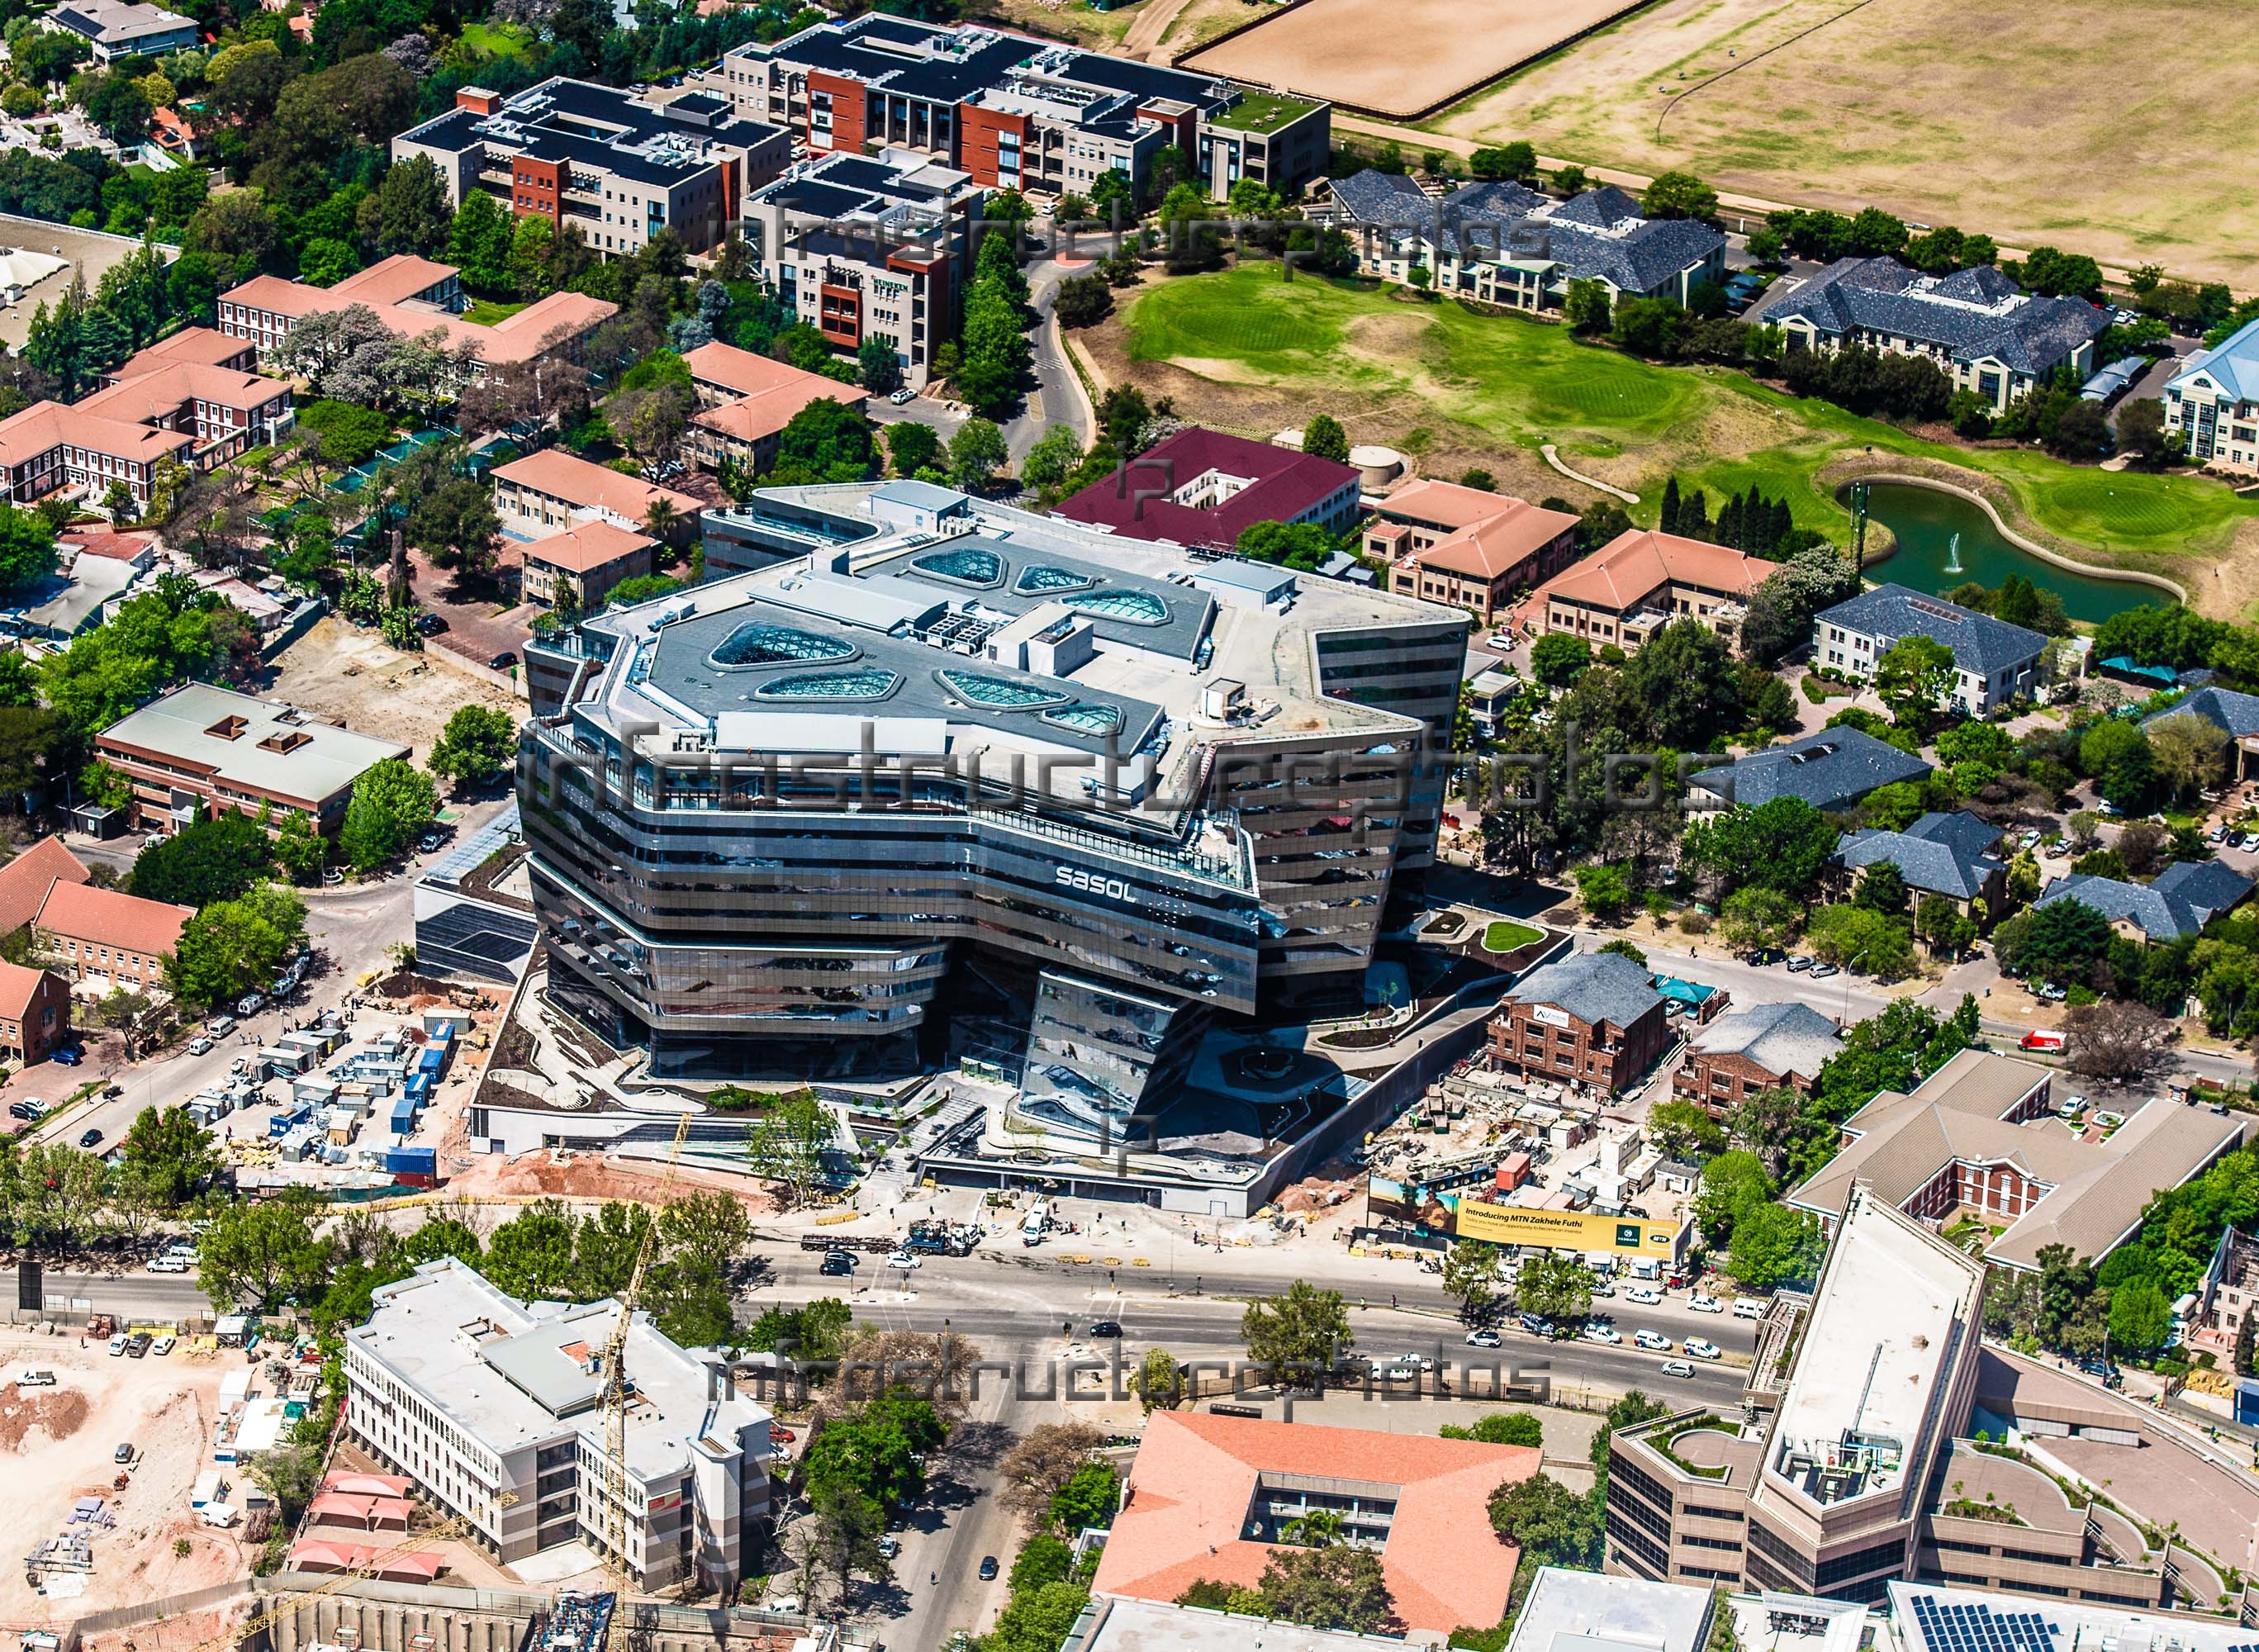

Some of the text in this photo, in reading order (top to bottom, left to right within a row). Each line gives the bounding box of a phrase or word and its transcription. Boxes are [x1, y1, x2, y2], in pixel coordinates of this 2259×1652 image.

[873, 278, 909, 292] HEINEKEN
[1465, 1208, 1510, 1222] Introducing
[1530, 1216, 1562, 1226] Zakhele
[1562, 1219, 1583, 1227] Futhi
